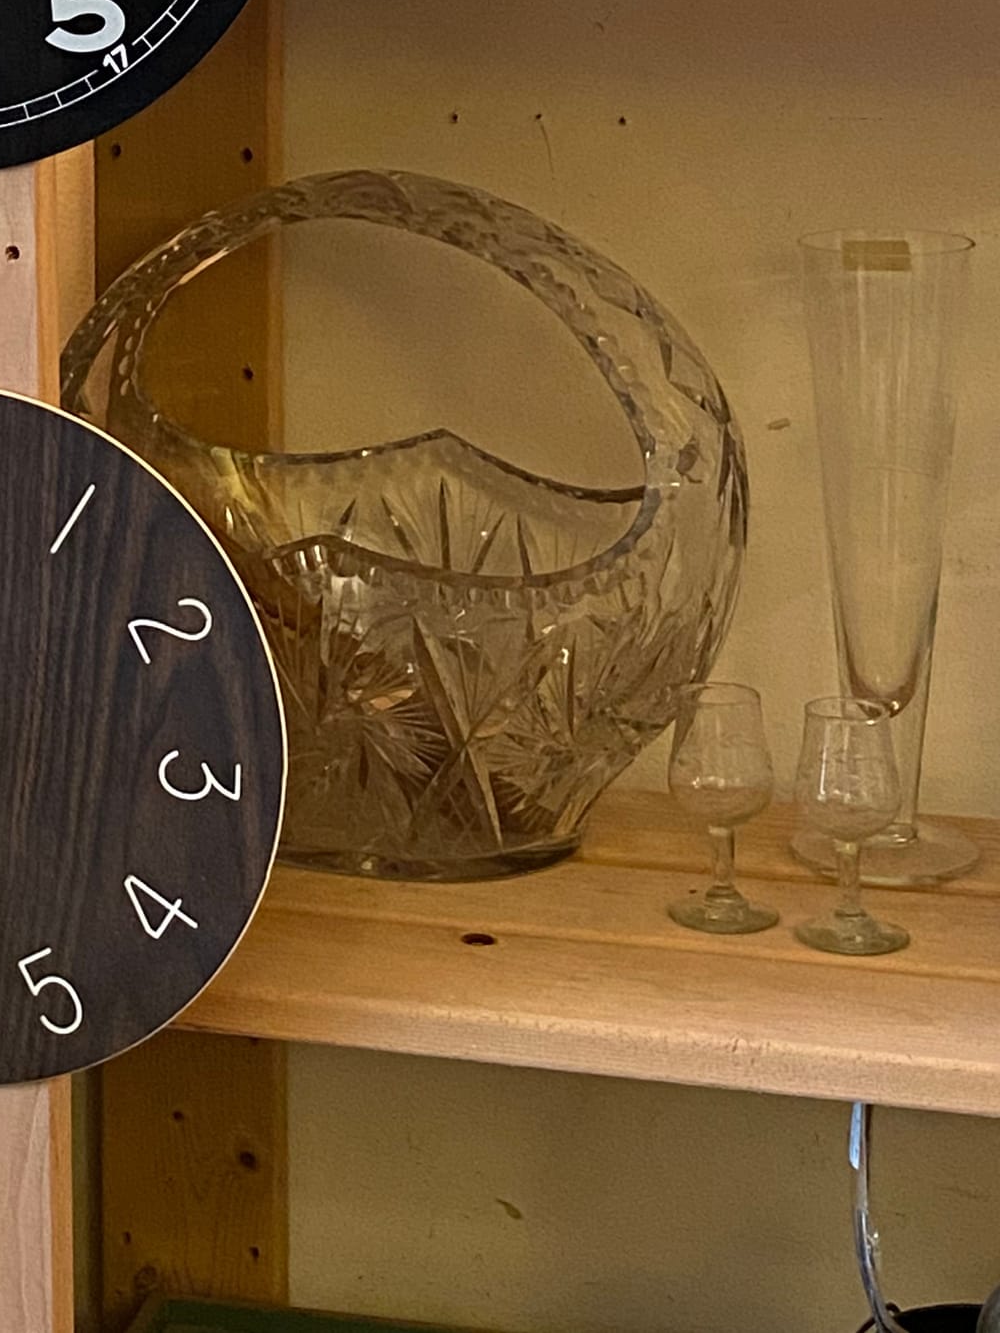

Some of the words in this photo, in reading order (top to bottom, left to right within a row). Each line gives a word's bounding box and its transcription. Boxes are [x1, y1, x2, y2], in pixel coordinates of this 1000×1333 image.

[103, 45, 131, 74] 17
[50, 485, 95, 553] 1
[128, 599, 212, 664] 2
[159, 751, 241, 800] 3
[124, 876, 198, 939] 4
[18, 948, 82, 1034] 5
